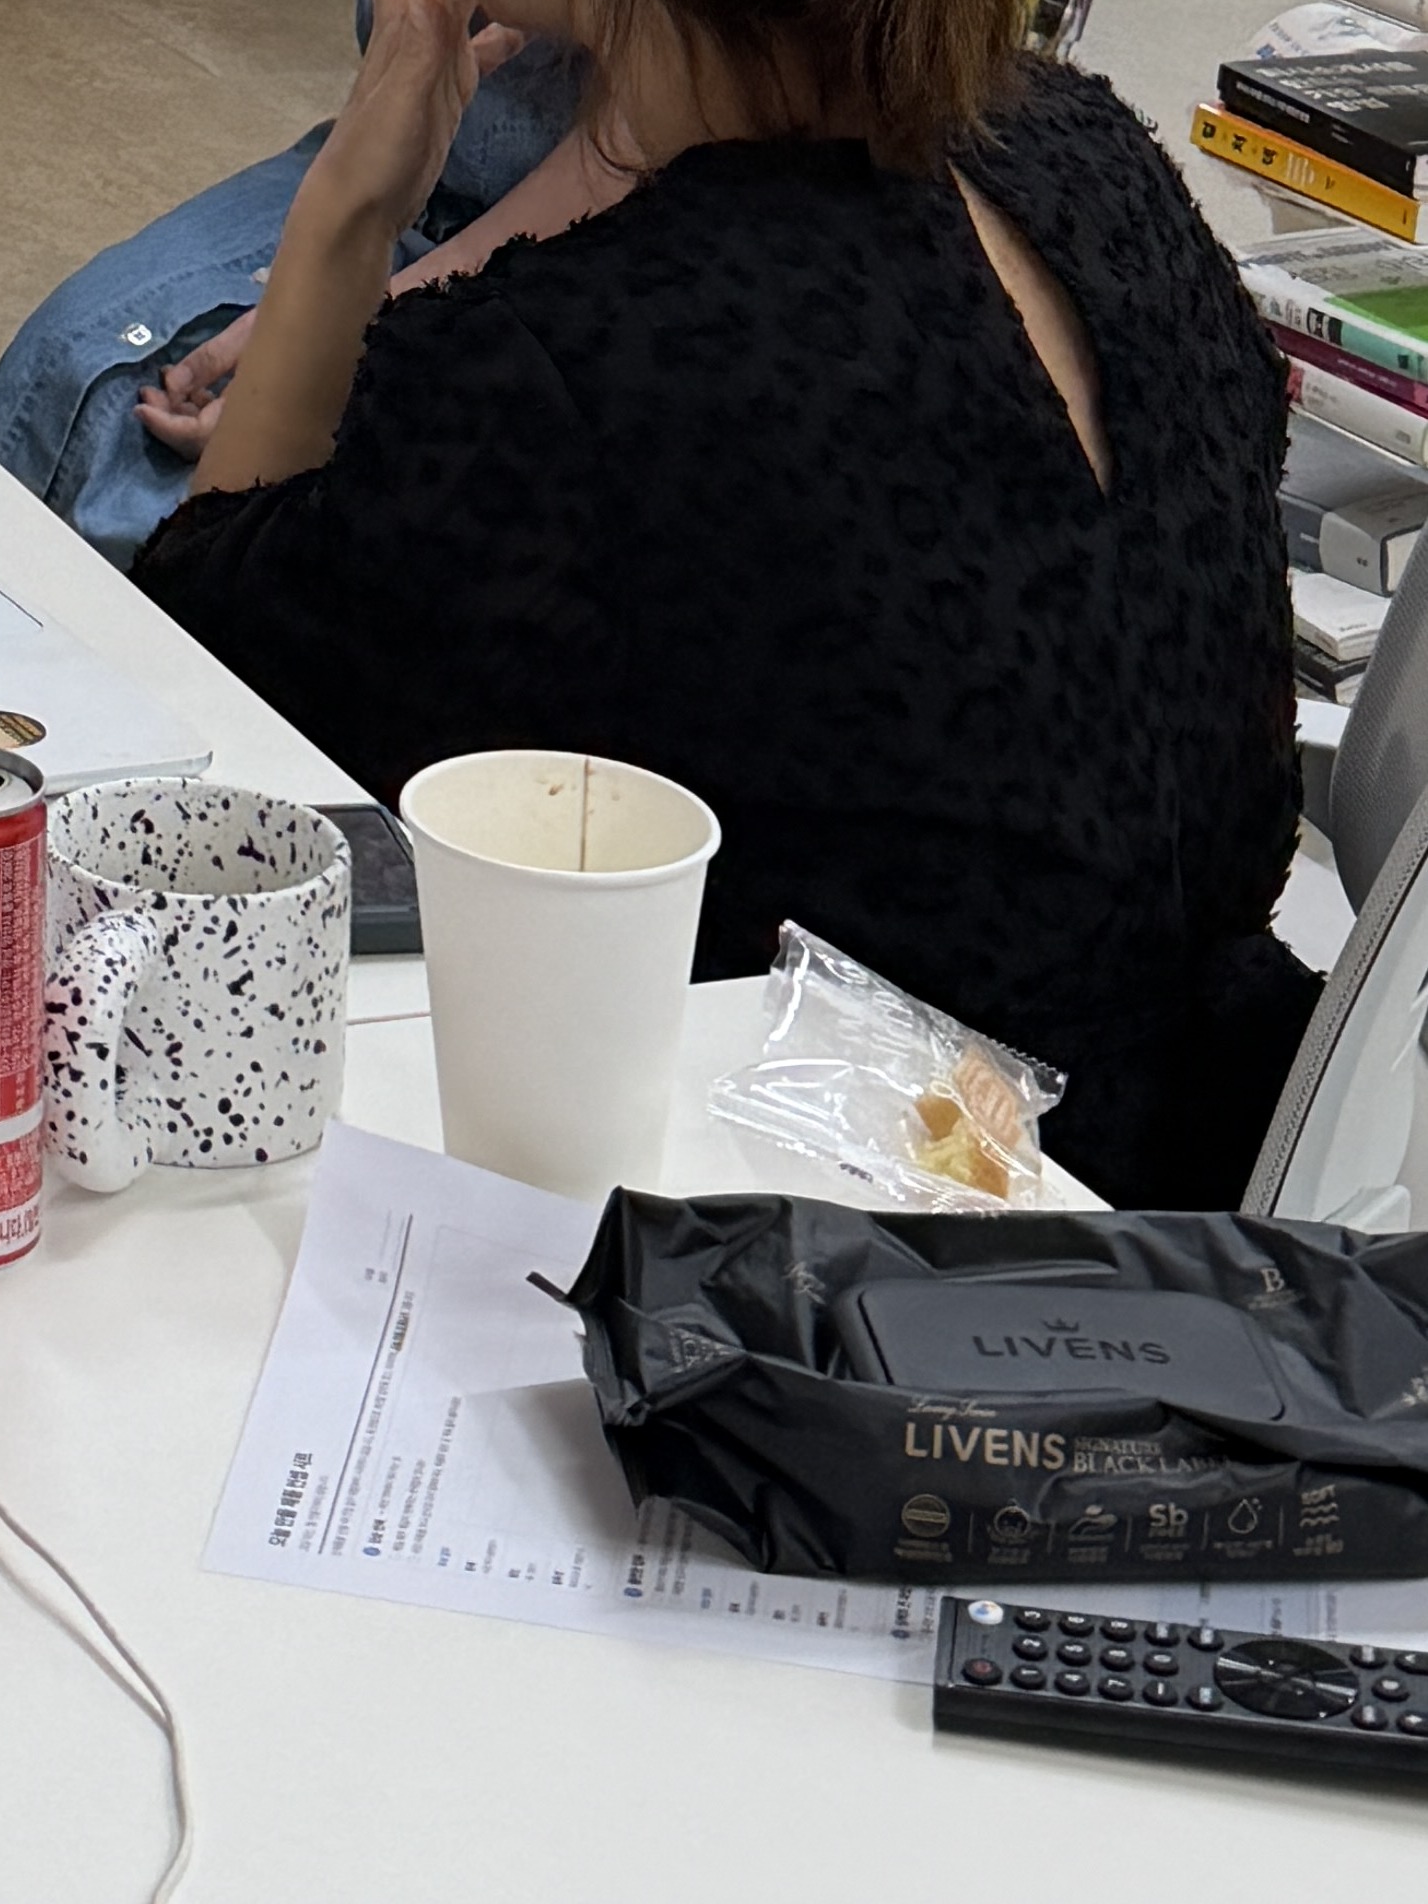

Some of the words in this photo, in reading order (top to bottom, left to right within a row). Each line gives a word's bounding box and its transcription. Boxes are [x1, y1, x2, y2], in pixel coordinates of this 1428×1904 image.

[1260, 1267, 1285, 1293] B
[972, 1335, 1171, 1364] LIVENS
[905, 1422, 1066, 1470] LIVENS
[1073, 1452, 1146, 1473] BLACK
[1149, 1503, 1189, 1527] Sb
